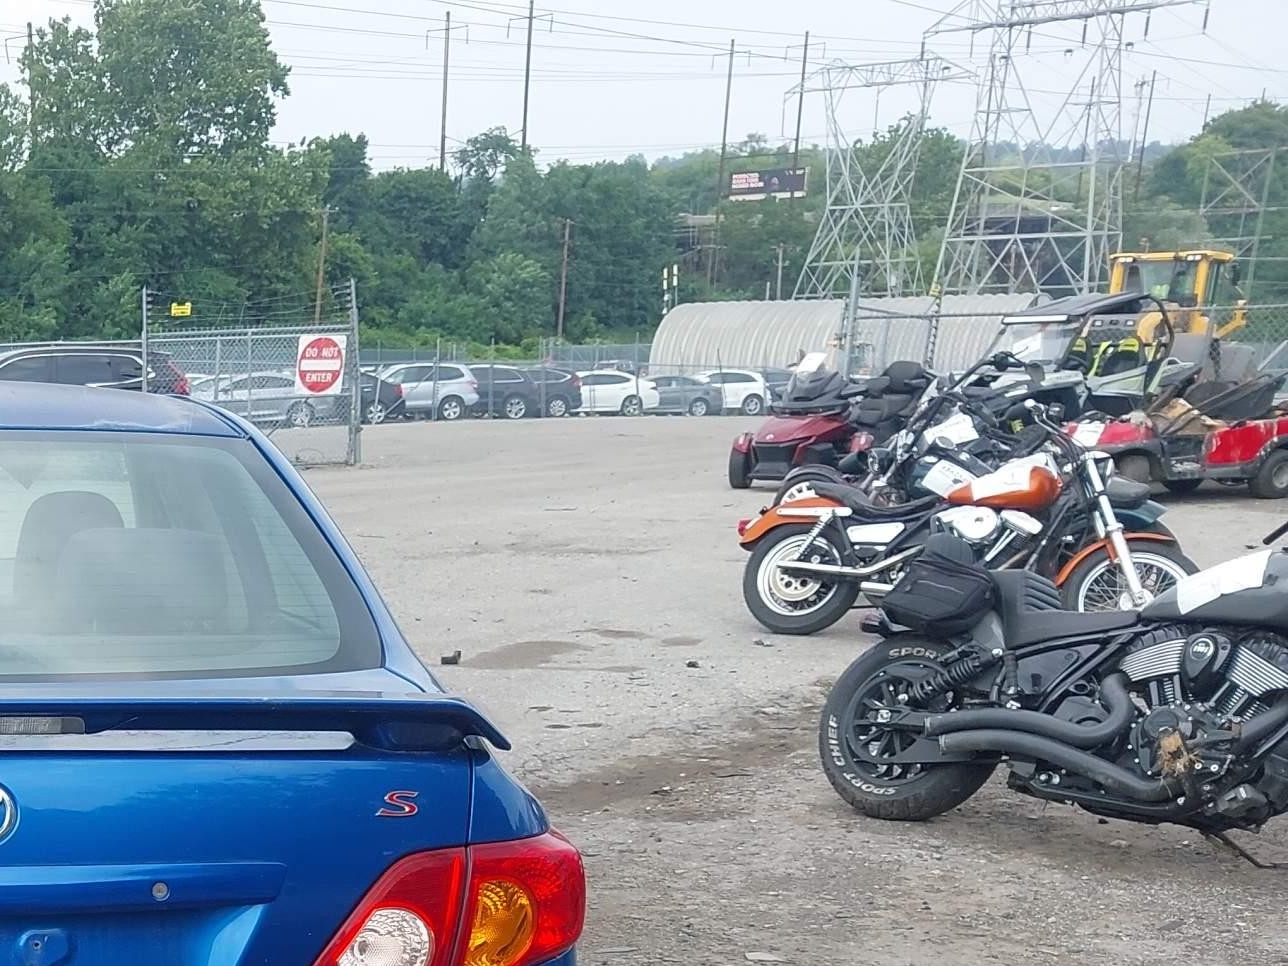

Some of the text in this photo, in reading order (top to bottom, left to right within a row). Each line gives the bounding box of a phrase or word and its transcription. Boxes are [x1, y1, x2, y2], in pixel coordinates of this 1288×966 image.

[305, 347, 339, 357] DO NOT
[305, 372, 332, 382] ENTER
[888, 647, 941, 660] SPOR
[827, 714, 898, 796] SPORT CHIEF
[375, 790, 419, 817] S
